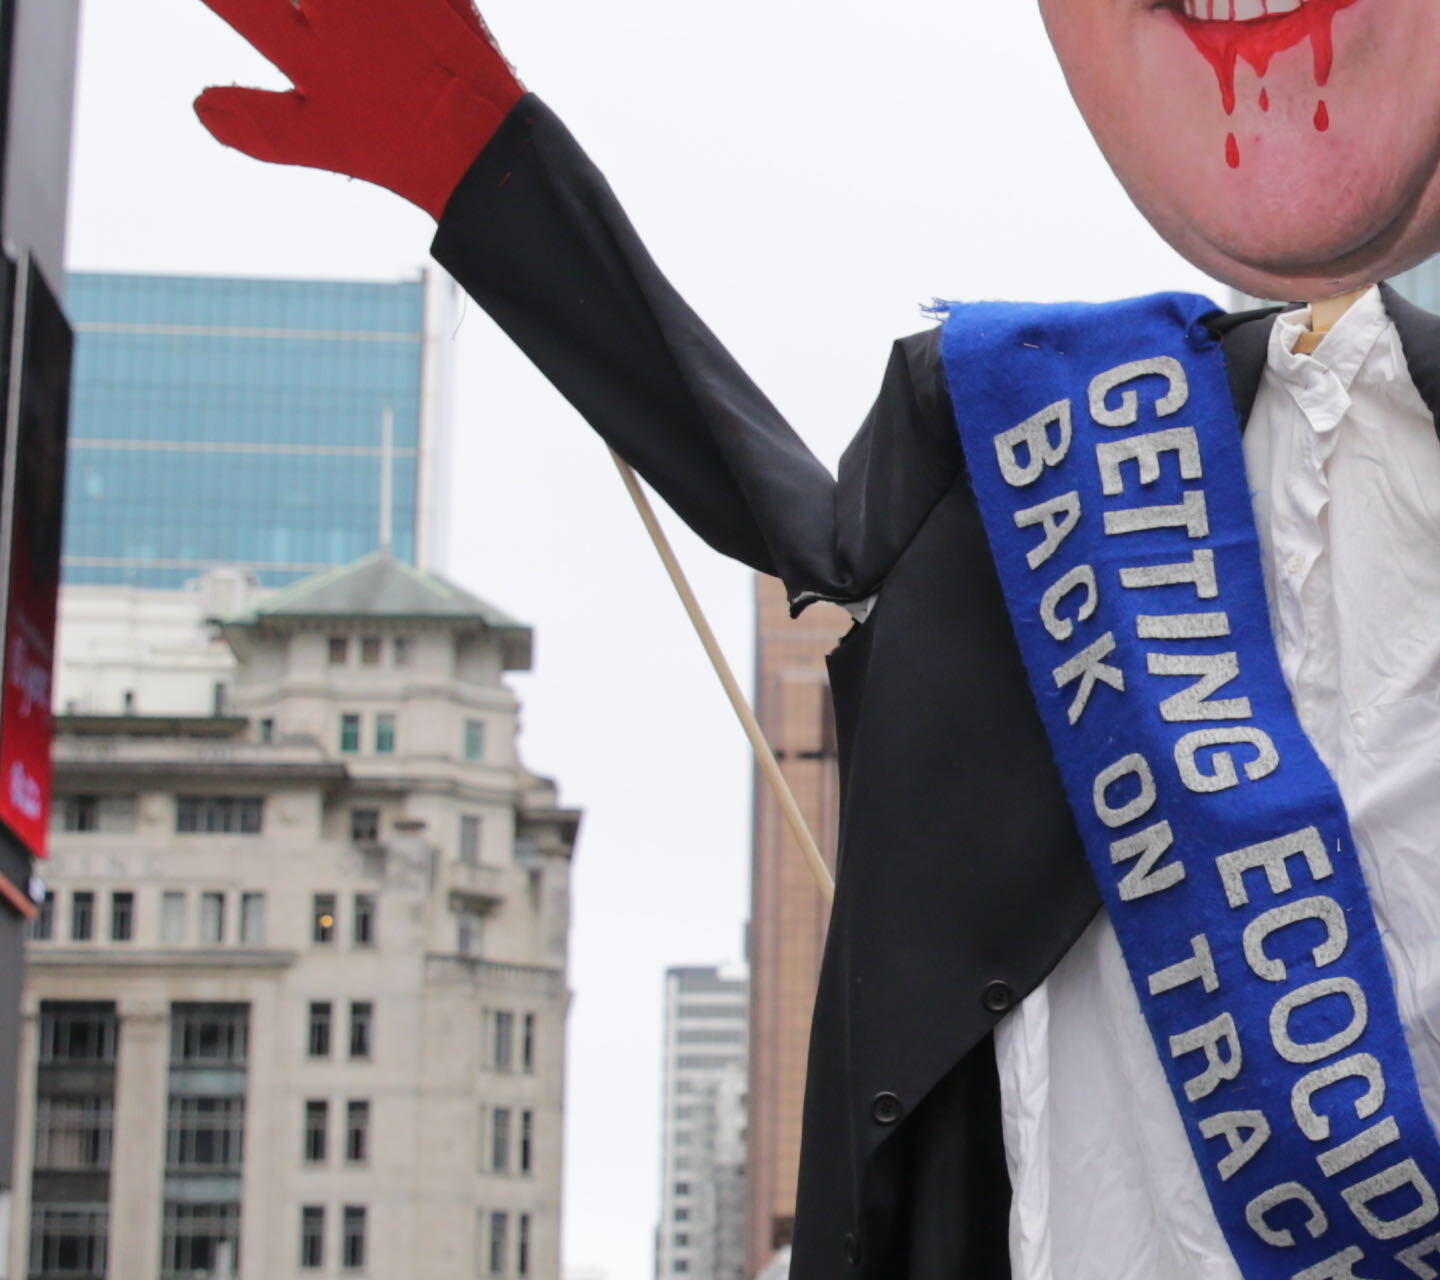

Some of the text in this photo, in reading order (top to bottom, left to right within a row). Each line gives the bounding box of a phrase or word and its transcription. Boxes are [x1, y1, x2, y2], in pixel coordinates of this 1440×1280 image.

[993, 398, 1126, 726] BACK
[1092, 752, 1187, 902] ON
[1088, 355, 1280, 794] GETTING
